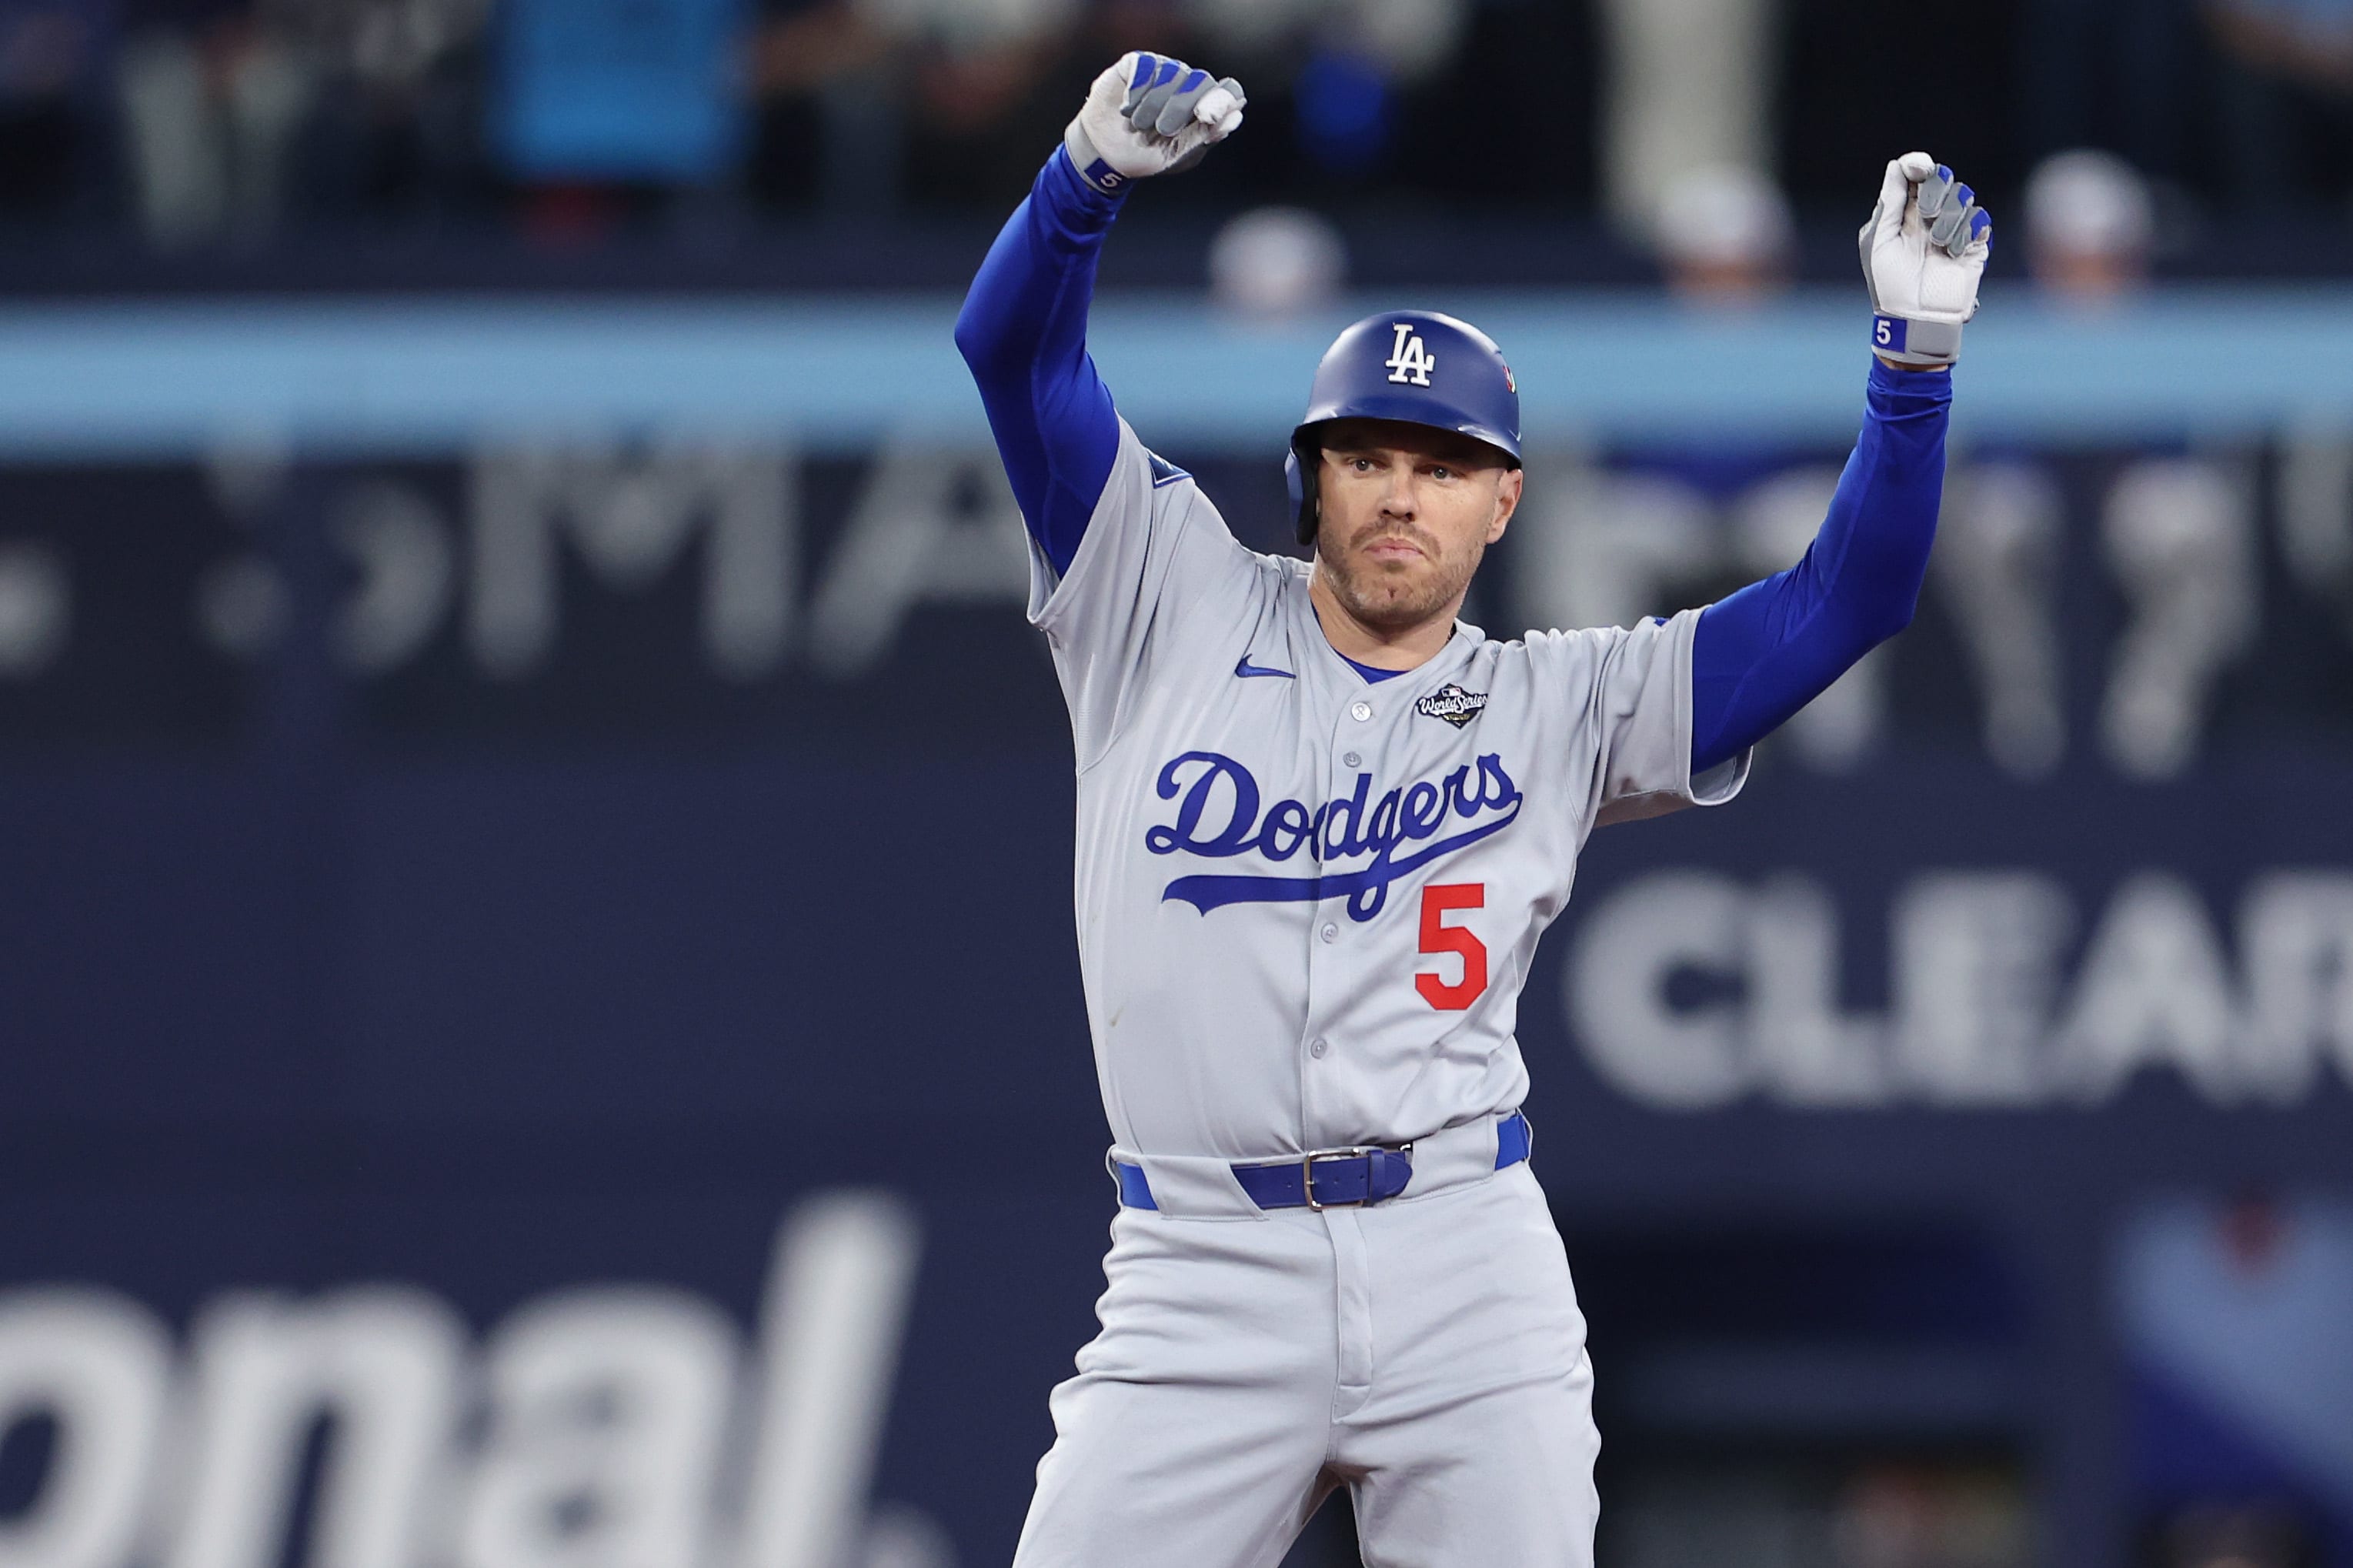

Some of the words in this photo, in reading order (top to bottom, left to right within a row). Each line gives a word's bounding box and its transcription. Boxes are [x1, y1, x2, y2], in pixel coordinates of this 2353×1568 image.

[1101, 172, 1123, 188] 5
[1876, 319, 1892, 345] 5
[1385, 323, 1436, 388] LA
[1419, 696, 1457, 715] World
[1145, 751, 1523, 922] Dodgers
[1414, 882, 1487, 1011] 5
